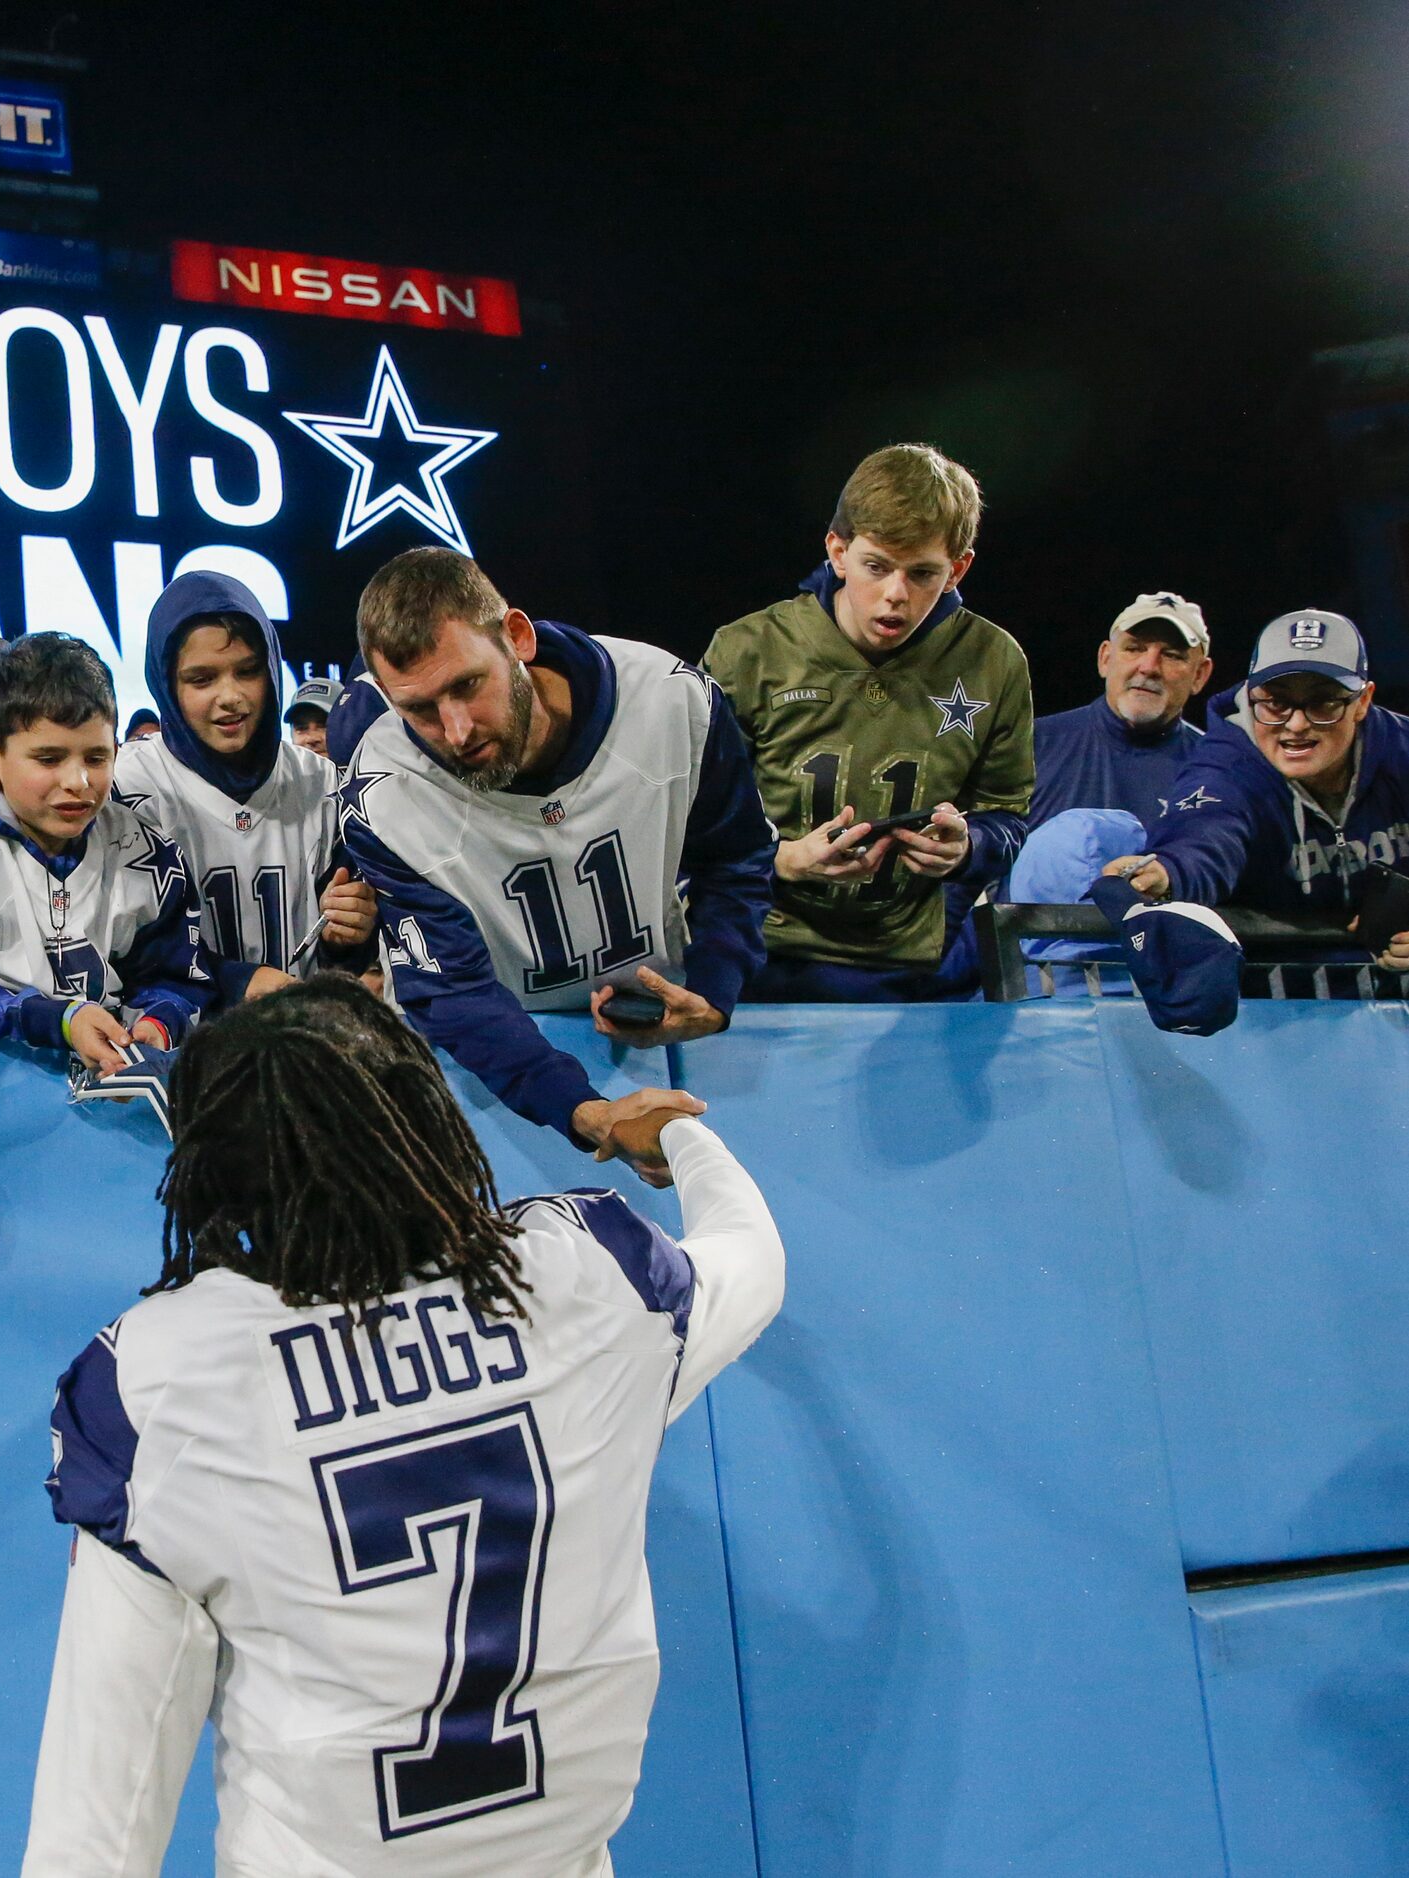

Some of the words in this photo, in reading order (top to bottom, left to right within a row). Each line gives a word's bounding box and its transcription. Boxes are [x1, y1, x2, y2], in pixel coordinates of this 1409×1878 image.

[218, 257, 477, 319] NISSAN
[783, 689, 818, 703] DALLAS
[544, 807, 567, 825] NFL
[200, 865, 298, 978] 11
[502, 828, 655, 995] 11
[269, 1294, 529, 1433] DIGGS
[310, 1401, 555, 1842] 7
